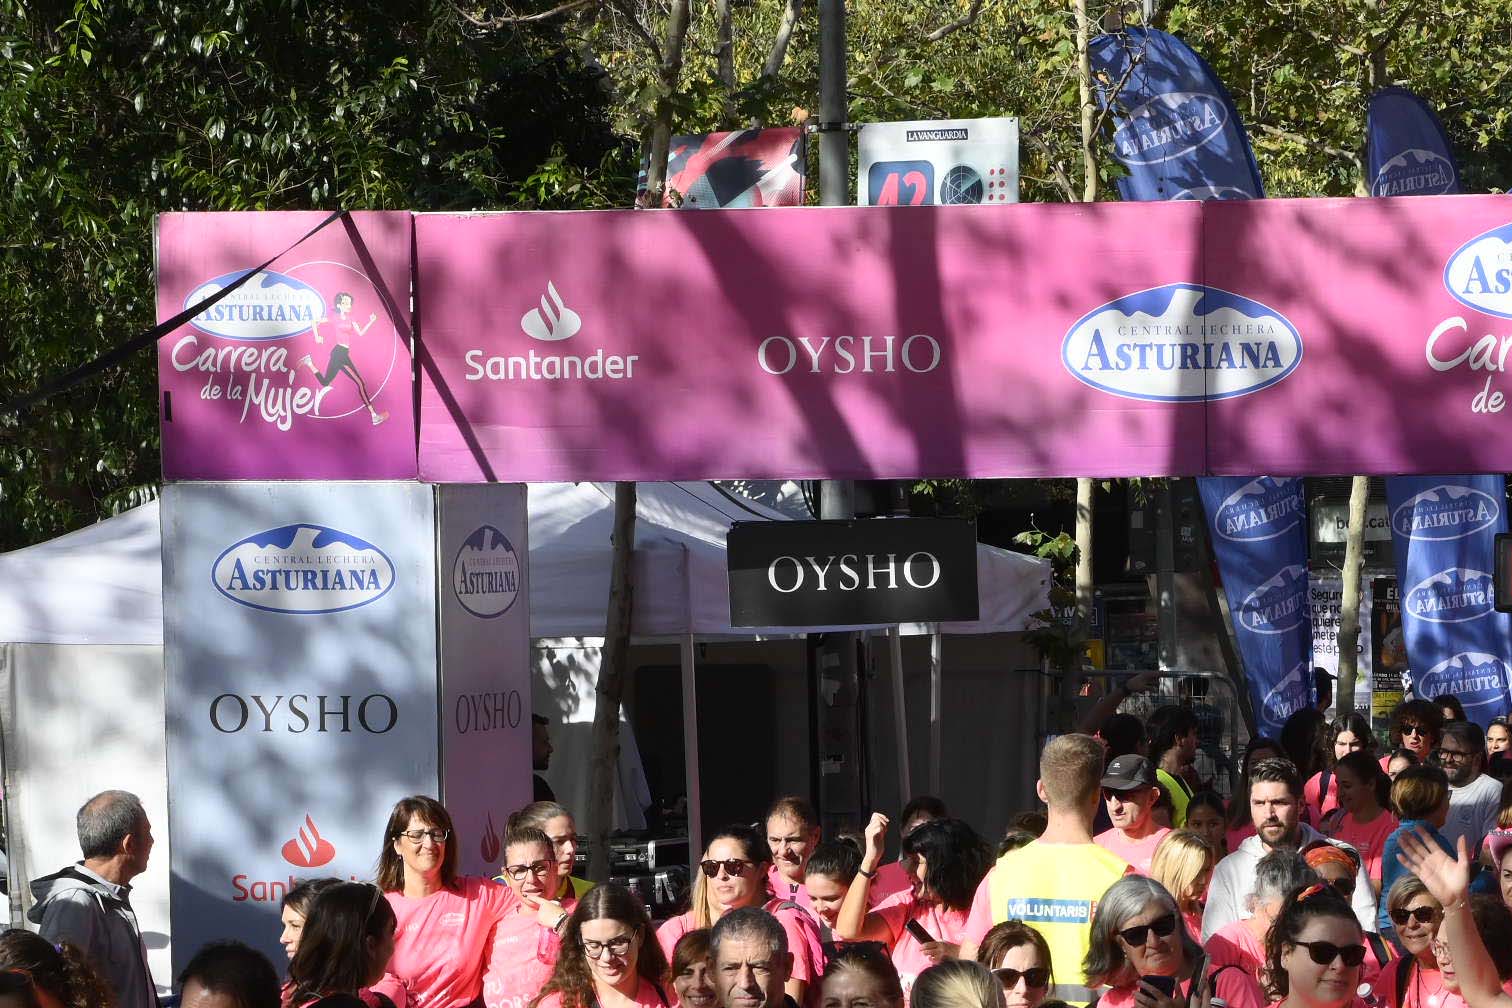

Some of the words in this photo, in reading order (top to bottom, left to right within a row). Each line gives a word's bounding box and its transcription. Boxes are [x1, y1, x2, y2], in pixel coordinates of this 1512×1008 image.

[196, 304, 312, 322] ASTURIANA
[1117, 325, 1194, 335] CENTRAL
[1201, 324, 1276, 335] LECHERA
[171, 335, 289, 373] Carrera
[465, 350, 639, 380] Santander
[757, 334, 941, 375] OYSHO
[1080, 328, 1283, 371] ASTURIANA
[200, 374, 222, 401] de
[227, 376, 242, 400] la
[239, 370, 333, 431] Mujer
[1470, 373, 1506, 414] de
[227, 557, 382, 592] ASTURIANA
[254, 555, 312, 565] CENTRAL
[317, 554, 376, 565] LECHERA
[768, 551, 941, 593] OYSHO
[458, 563, 517, 596] ASTURIANA
[209, 693, 399, 734] OYSHO
[456, 690, 522, 735] OYSHO
[1008, 903, 1088, 918] VOLUNTARIS
